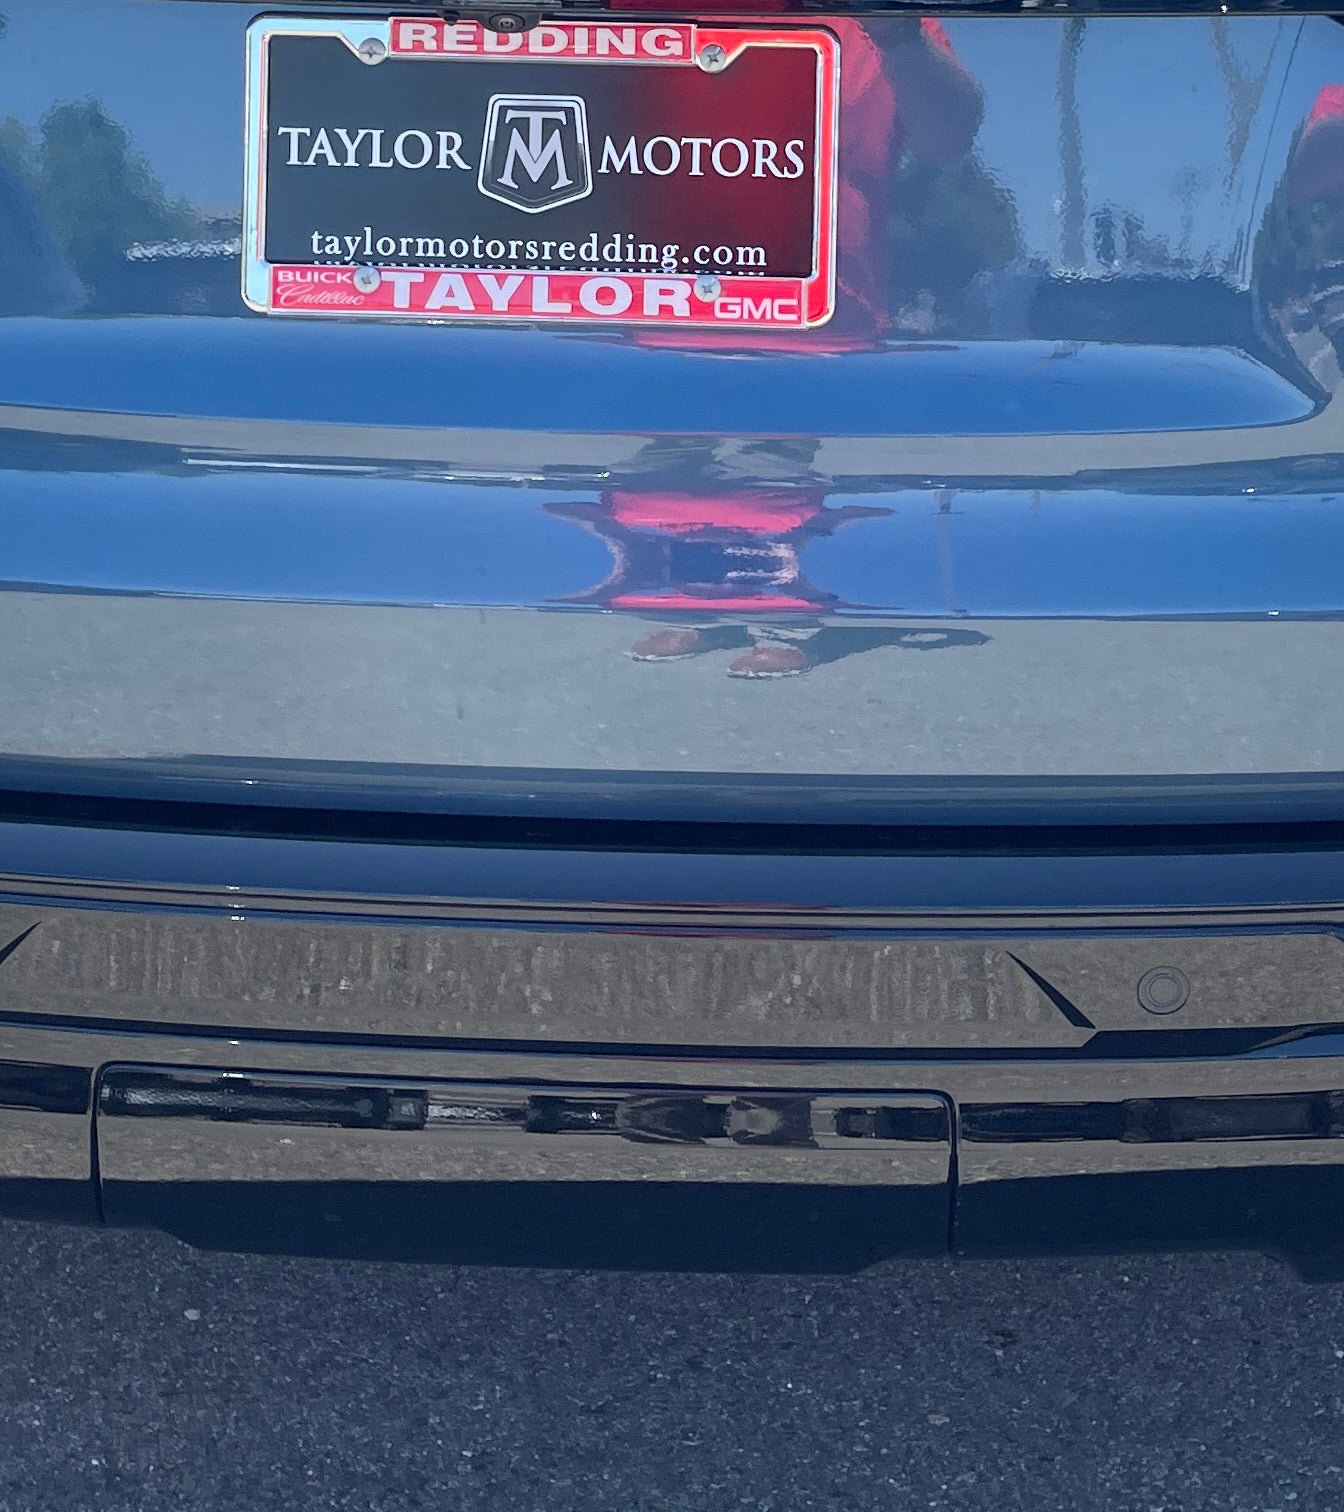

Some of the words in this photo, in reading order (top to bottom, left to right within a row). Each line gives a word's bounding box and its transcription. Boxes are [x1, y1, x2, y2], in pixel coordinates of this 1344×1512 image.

[399, 21, 684, 57] REDDING
[277, 126, 473, 172] TAYLOR
[597, 135, 806, 180] MOTORS
[311, 226, 768, 270] taylormotorsredding.com
[276, 284, 366, 307] Cadillac
[277, 270, 354, 285] BUICK
[379, 271, 693, 318] TAYLOR
[712, 296, 799, 321] GMC
